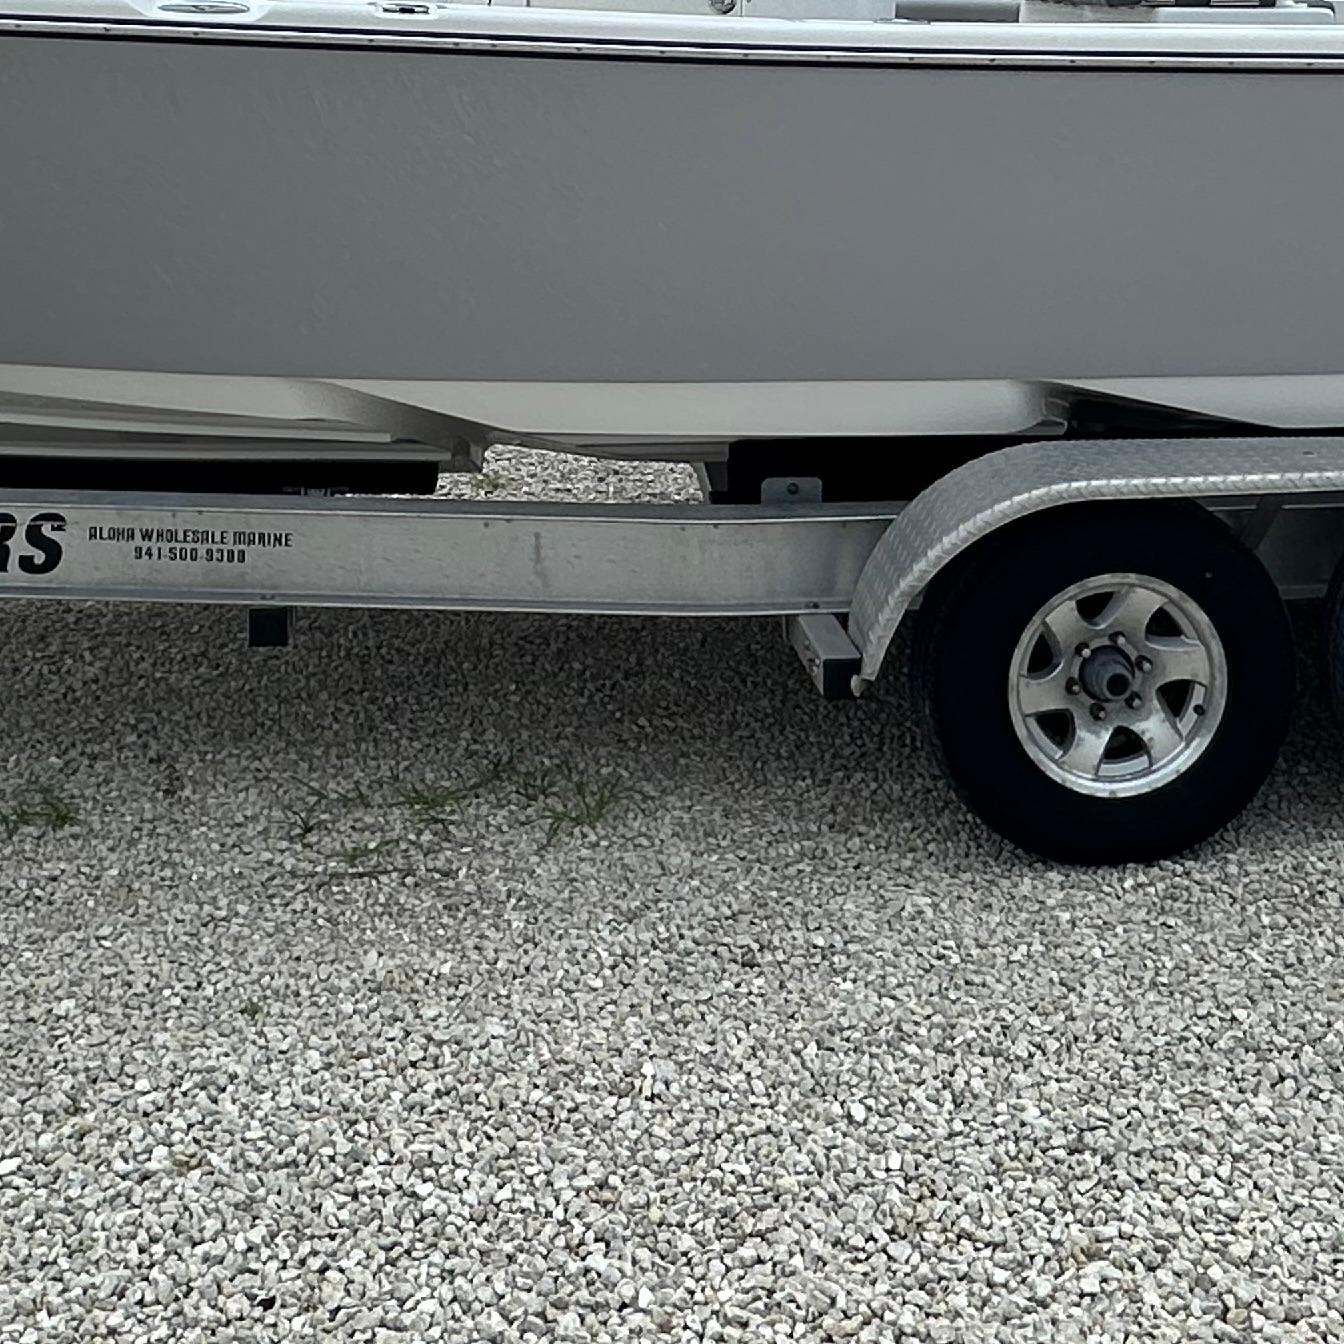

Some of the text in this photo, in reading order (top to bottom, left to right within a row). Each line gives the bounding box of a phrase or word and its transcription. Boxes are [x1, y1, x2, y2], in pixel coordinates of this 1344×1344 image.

[88, 526, 294, 547] ALOHA WHOLESALE MARINE
